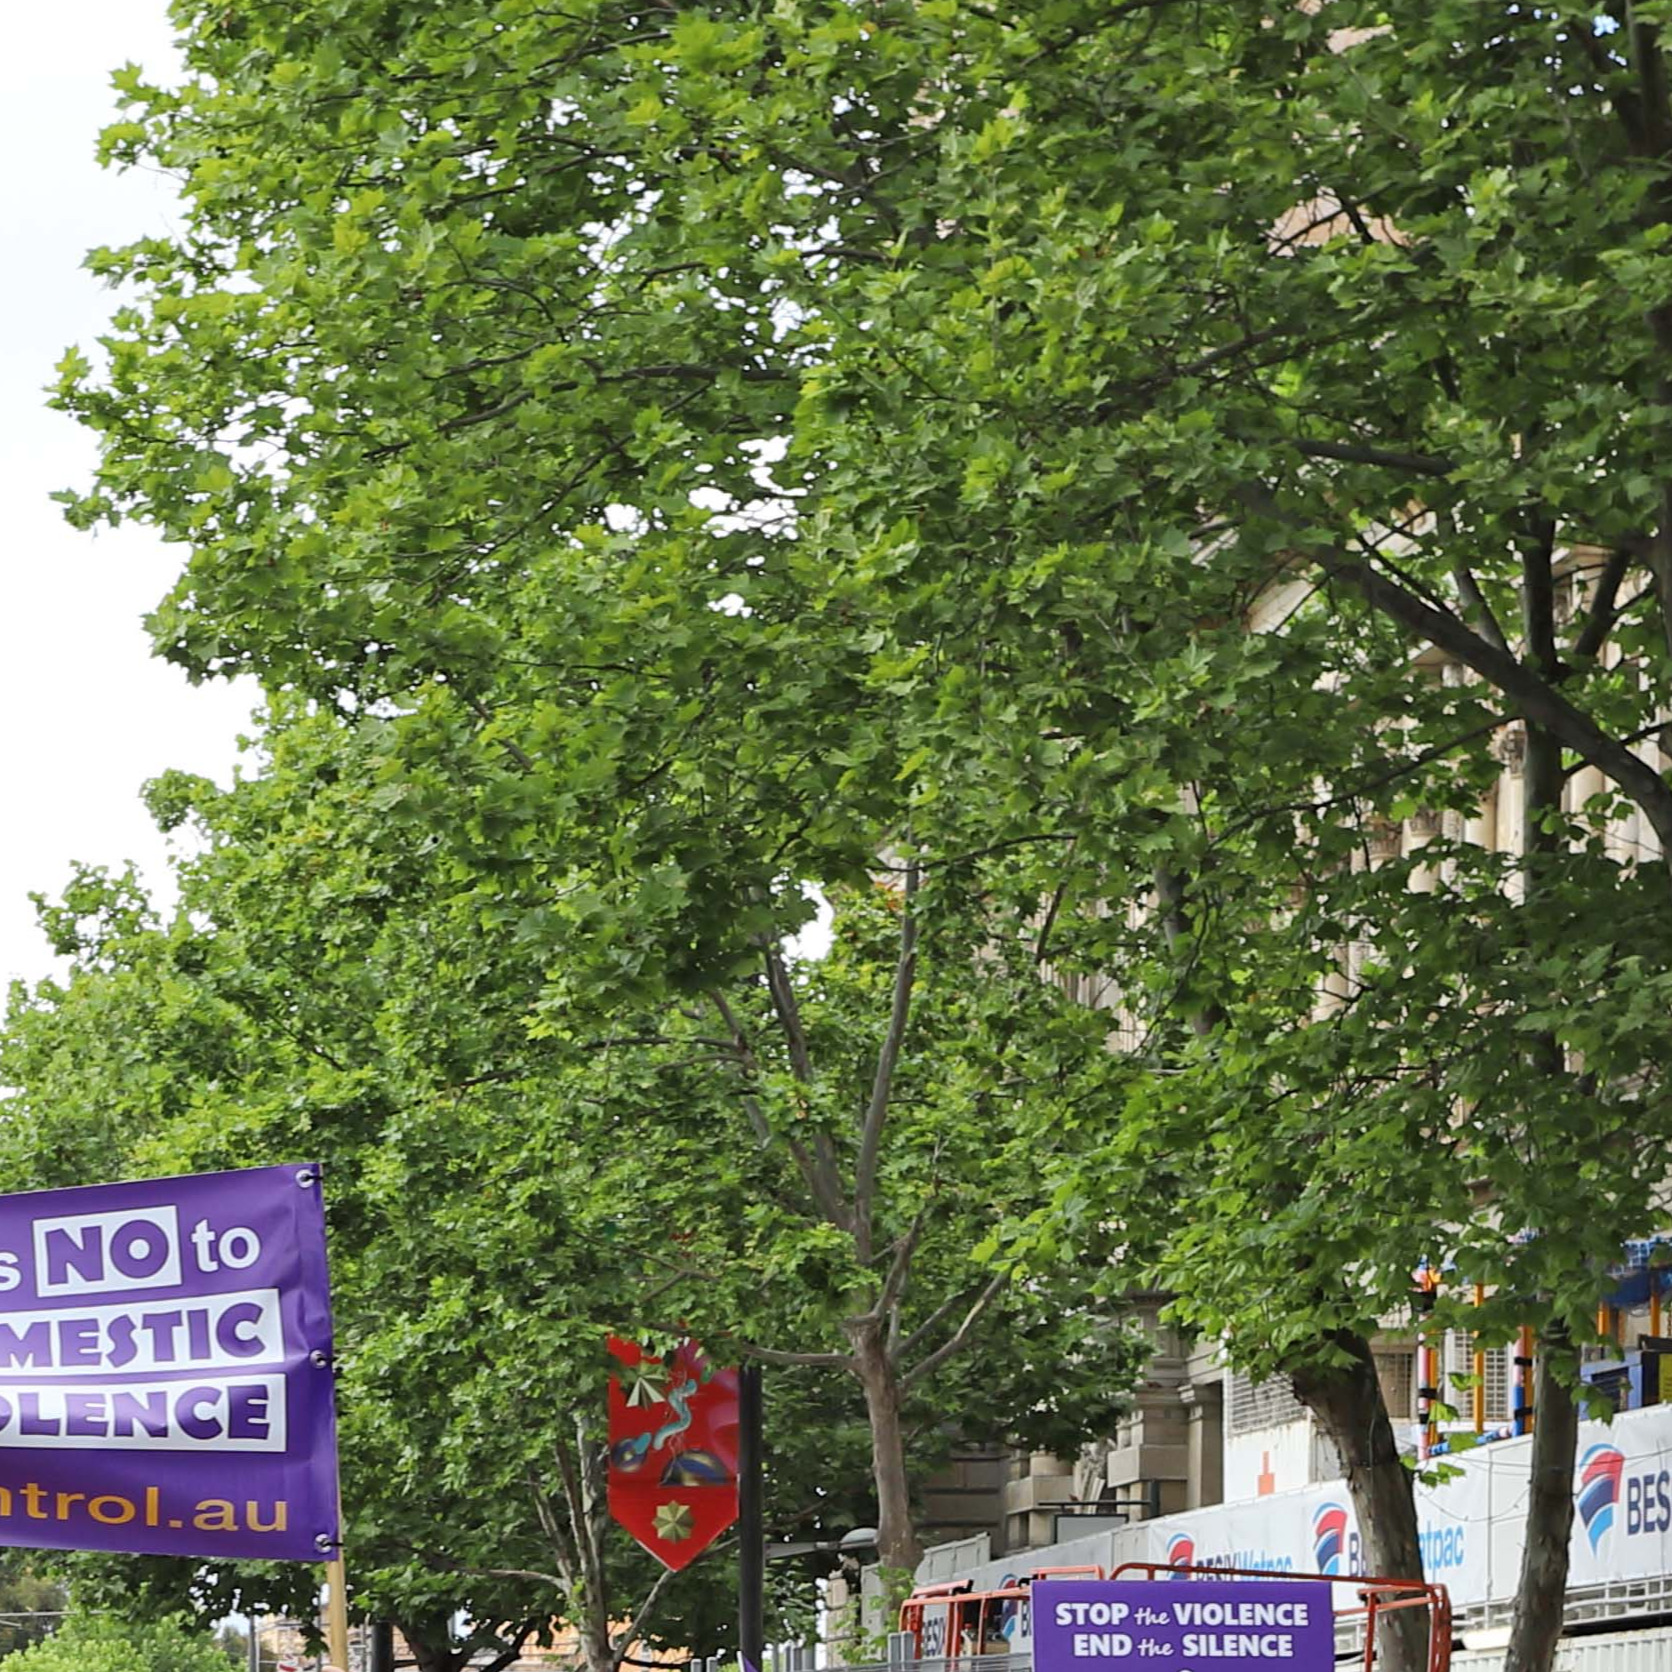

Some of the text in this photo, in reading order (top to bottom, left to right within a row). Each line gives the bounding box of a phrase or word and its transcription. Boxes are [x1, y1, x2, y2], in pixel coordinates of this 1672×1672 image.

[45, 1220, 171, 1285] NO
[190, 1219, 261, 1273] to
[1055, 1602, 1129, 1627] STOP
[1134, 1605, 1171, 1626] the
[1173, 1602, 1309, 1627] VIOLENCE
[1073, 1633, 1294, 1658] END the SILENCE
